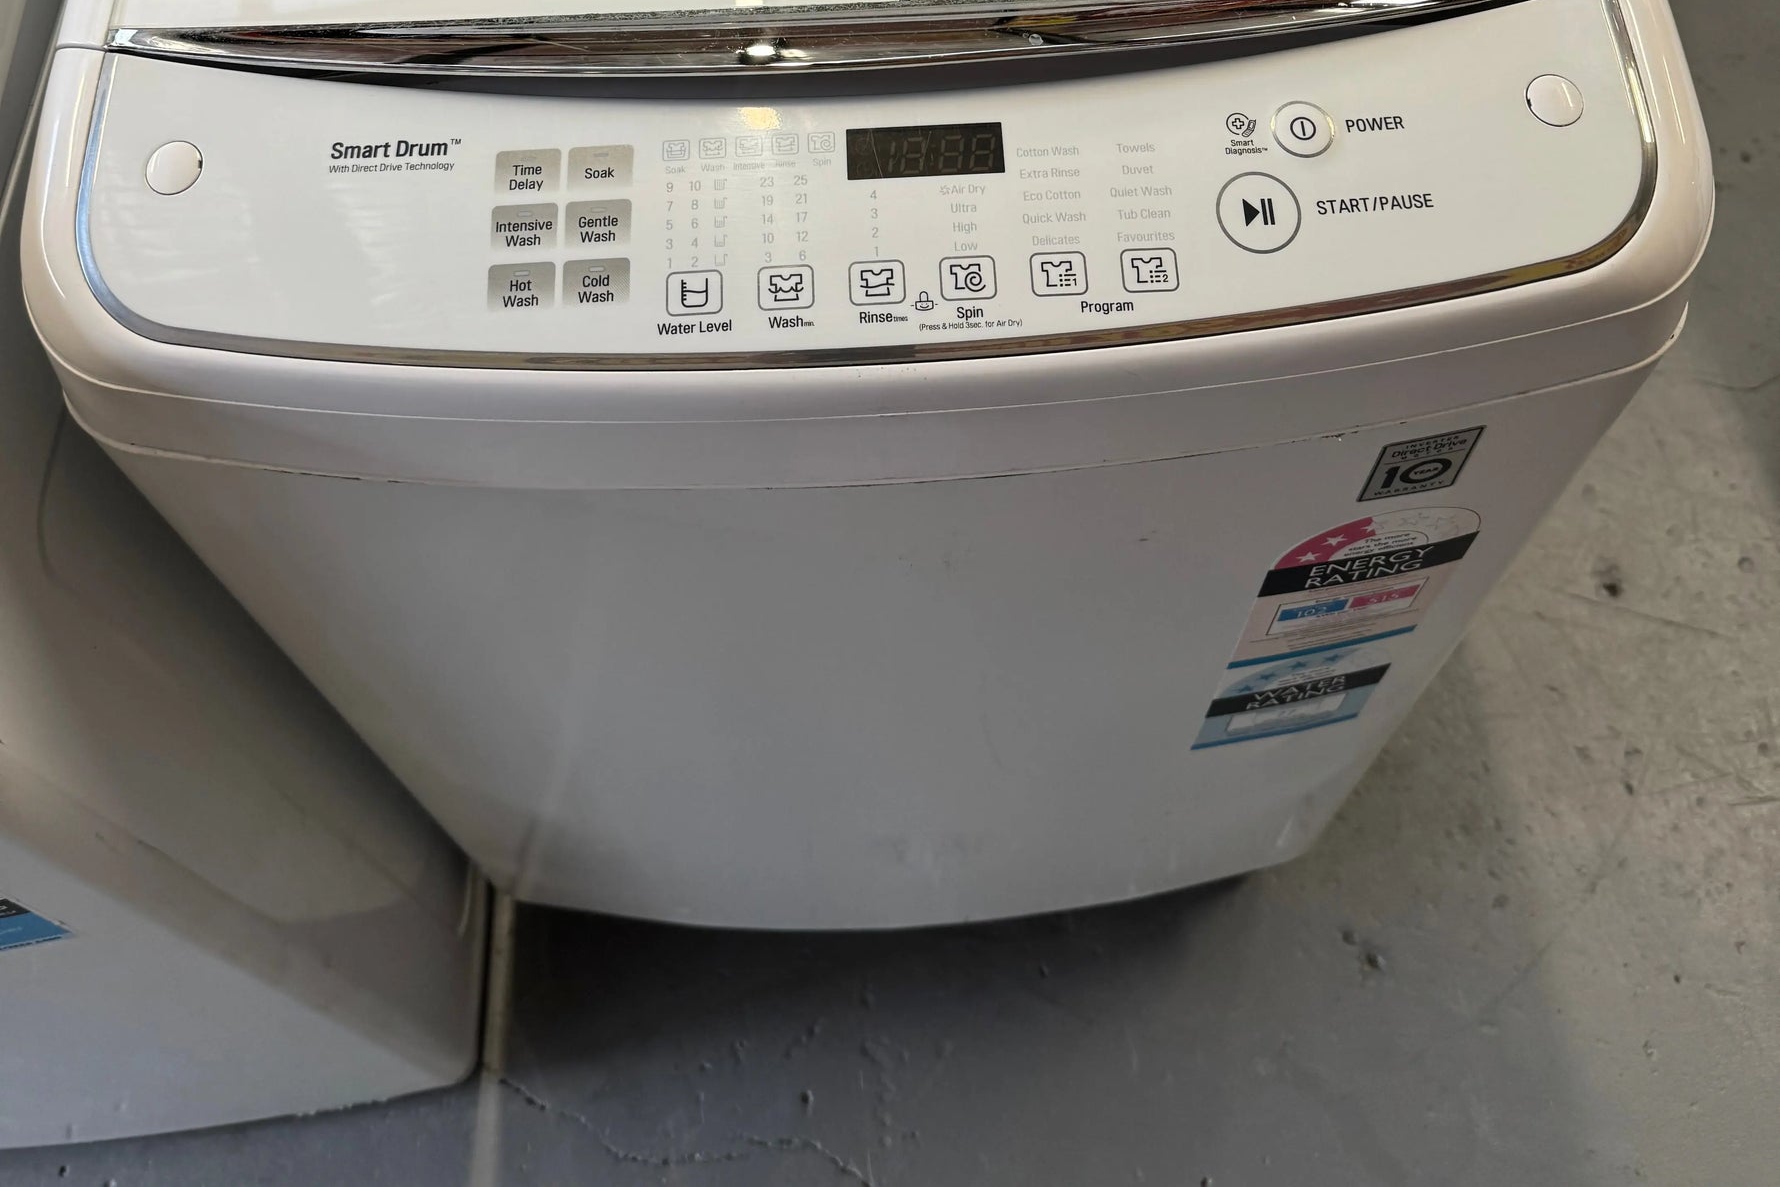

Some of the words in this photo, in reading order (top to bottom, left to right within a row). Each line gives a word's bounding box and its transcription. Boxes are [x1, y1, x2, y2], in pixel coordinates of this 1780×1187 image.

[1345, 115, 1405, 134] POWER
[1116, 142, 1156, 154] Towels
[1230, 139, 1254, 147] Smart
[330, 141, 390, 159] Smart
[1016, 147, 1049, 158] Cotton
[1051, 146, 1080, 157] Wash
[328, 163, 350, 173] With
[351, 162, 378, 173] Direct
[379, 161, 403, 172] Drive
[404, 161, 455, 173] Technology
[701, 163, 726, 173] Wash
[733, 162, 766, 172] Intensive
[812, 157, 832, 167] Spin
[512, 164, 543, 176] Time
[584, 166, 615, 179] Soak
[665, 165, 686, 175] Soak
[1019, 169, 1048, 180] Extra
[1051, 167, 1080, 178] Rinse
[1121, 165, 1154, 175] Duvet
[509, 178, 544, 191] Delay
[666, 182, 674, 193] 9
[688, 180, 701, 192] 10
[759, 176, 774, 188] 23
[793, 175, 808, 186] 25
[870, 189, 877, 200] 4
[951, 185, 966, 194] Air
[968, 184, 986, 195] Dry
[1023, 191, 1043, 202] Eco
[1045, 189, 1081, 201] Cotton
[1109, 187, 1138, 198] Quiet
[1140, 185, 1173, 197] Wash
[691, 199, 699, 211] 8
[761, 195, 774, 206] 19
[795, 193, 808, 204] 21
[1316, 193, 1435, 216] START/PAUSE
[666, 201, 674, 212] 7
[950, 202, 977, 213] Ultra
[761, 214, 774, 225] 14
[795, 212, 808, 223] 17
[871, 208, 878, 219] 3
[1022, 212, 1052, 224] Quick
[1055, 211, 1086, 223] Wash
[1118, 209, 1138, 220] Tub
[1140, 207, 1171, 219] Clean
[495, 218, 553, 234] Intensive
[578, 215, 619, 229] Gentle
[665, 219, 673, 231] 5
[691, 218, 699, 229] 6
[952, 222, 977, 234] High
[579, 230, 616, 244] Wash
[762, 233, 774, 244] 10
[796, 231, 808, 242] 12
[871, 227, 879, 238] 2
[1117, 231, 1175, 243] Favourites
[505, 234, 541, 248] Wash
[665, 238, 673, 250] 3
[691, 237, 699, 248] 4
[954, 241, 978, 252] Low
[1032, 235, 1081, 247] Delicates
[691, 256, 699, 268] 2
[764, 252, 772, 263] 3
[799, 250, 807, 261] 6
[509, 279, 532, 292] Hot
[582, 274, 610, 288] Cold
[502, 294, 539, 308] Wash
[577, 290, 614, 304] Wash
[956, 306, 984, 321] Spin
[1080, 301, 1134, 315] Program
[768, 315, 804, 329] Wash
[859, 310, 893, 324] Rinse
[657, 321, 697, 336] Water
[699, 319, 732, 334] Level
[919, 322, 941, 332] (Press
[949, 321, 964, 330] Hold
[985, 319, 994, 328] for
[996, 319, 1007, 327] Air
[1007, 318, 1023, 329] Dry)
[1392, 446, 1432, 459] Direct
[1434, 438, 1467, 451] Drive
[1406, 435, 1460, 449] INVERTER
[1380, 458, 1453, 489] 10
[1414, 466, 1440, 475] YEAR
[1374, 479, 1446, 496] WARRANTY
[1309, 546, 1435, 577] ENERGY
[1304, 559, 1425, 589] RATING
[1254, 676, 1346, 701] WATER
[1245, 686, 1345, 710] RATING
